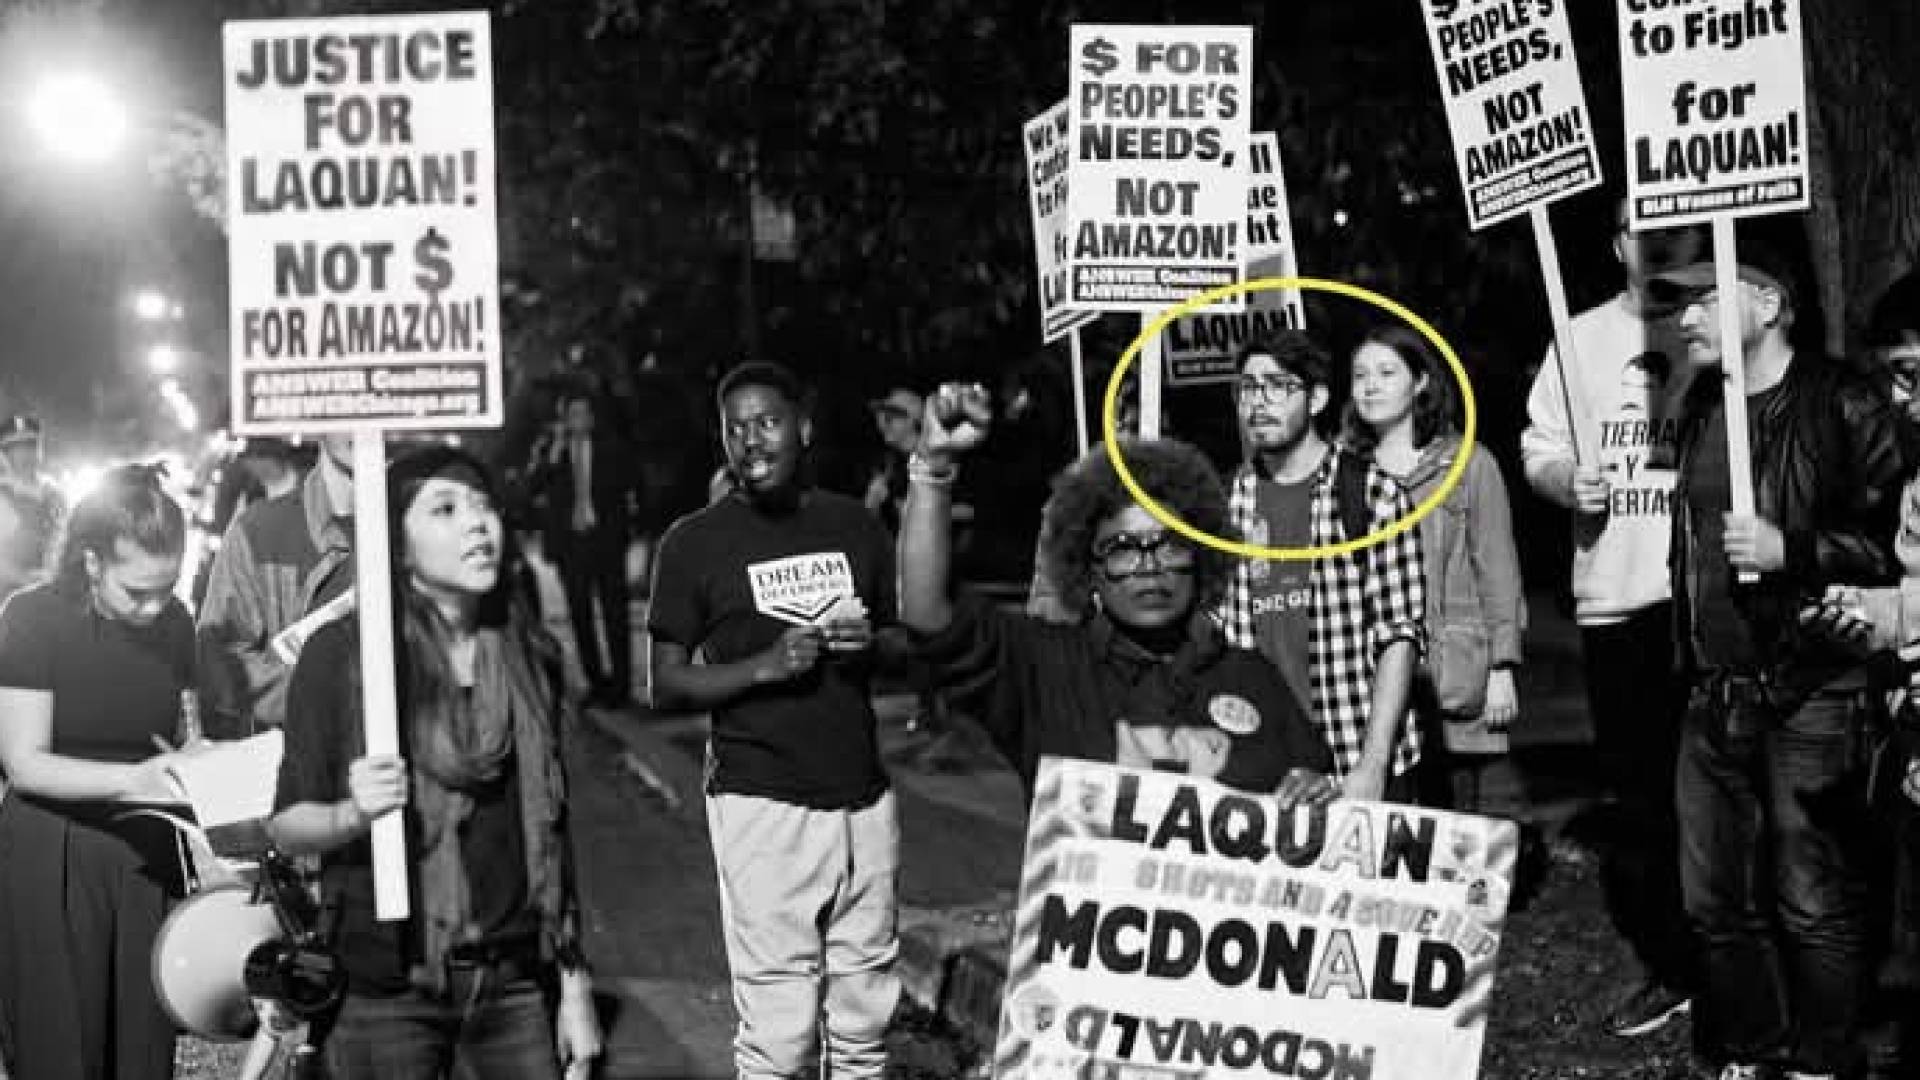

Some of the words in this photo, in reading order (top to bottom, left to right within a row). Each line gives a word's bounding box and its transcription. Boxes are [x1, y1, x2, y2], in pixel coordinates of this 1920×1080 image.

[1081, 37, 1120, 77] $
[1136, 42, 1240, 75] FOR
[1438, 0, 1554, 61] PEOPLES
[1630, 19, 1674, 57] to
[1684, 0, 1788, 50] Fight
[237, 29, 475, 88] JUSTICE
[1446, 28, 1562, 97] NEEDS,
[304, 92, 411, 151] FOR
[1080, 80, 1239, 120] PEOPLE'S
[1482, 81, 1543, 135] NOT
[1672, 81, 1756, 126] for
[1079, 123, 1235, 168] NEEDS,
[1466, 105, 1585, 184] AMAZON!
[1636, 111, 1799, 184] LAQUAN!
[242, 150, 477, 214] LAQUAN!
[1115, 177, 1200, 217] NOT
[275, 241, 393, 296] NOT
[414, 226, 453, 306] $
[1075, 220, 1237, 260] AMAZON!
[243, 308, 306, 359] FOR
[319, 296, 485, 358] AMAZON!
[1624, 454, 1639, 480] Y
[757, 559, 846, 587] DREAM
[1111, 775, 1436, 883] LAQUAN
[1037, 893, 1467, 1009] MCDONALD
